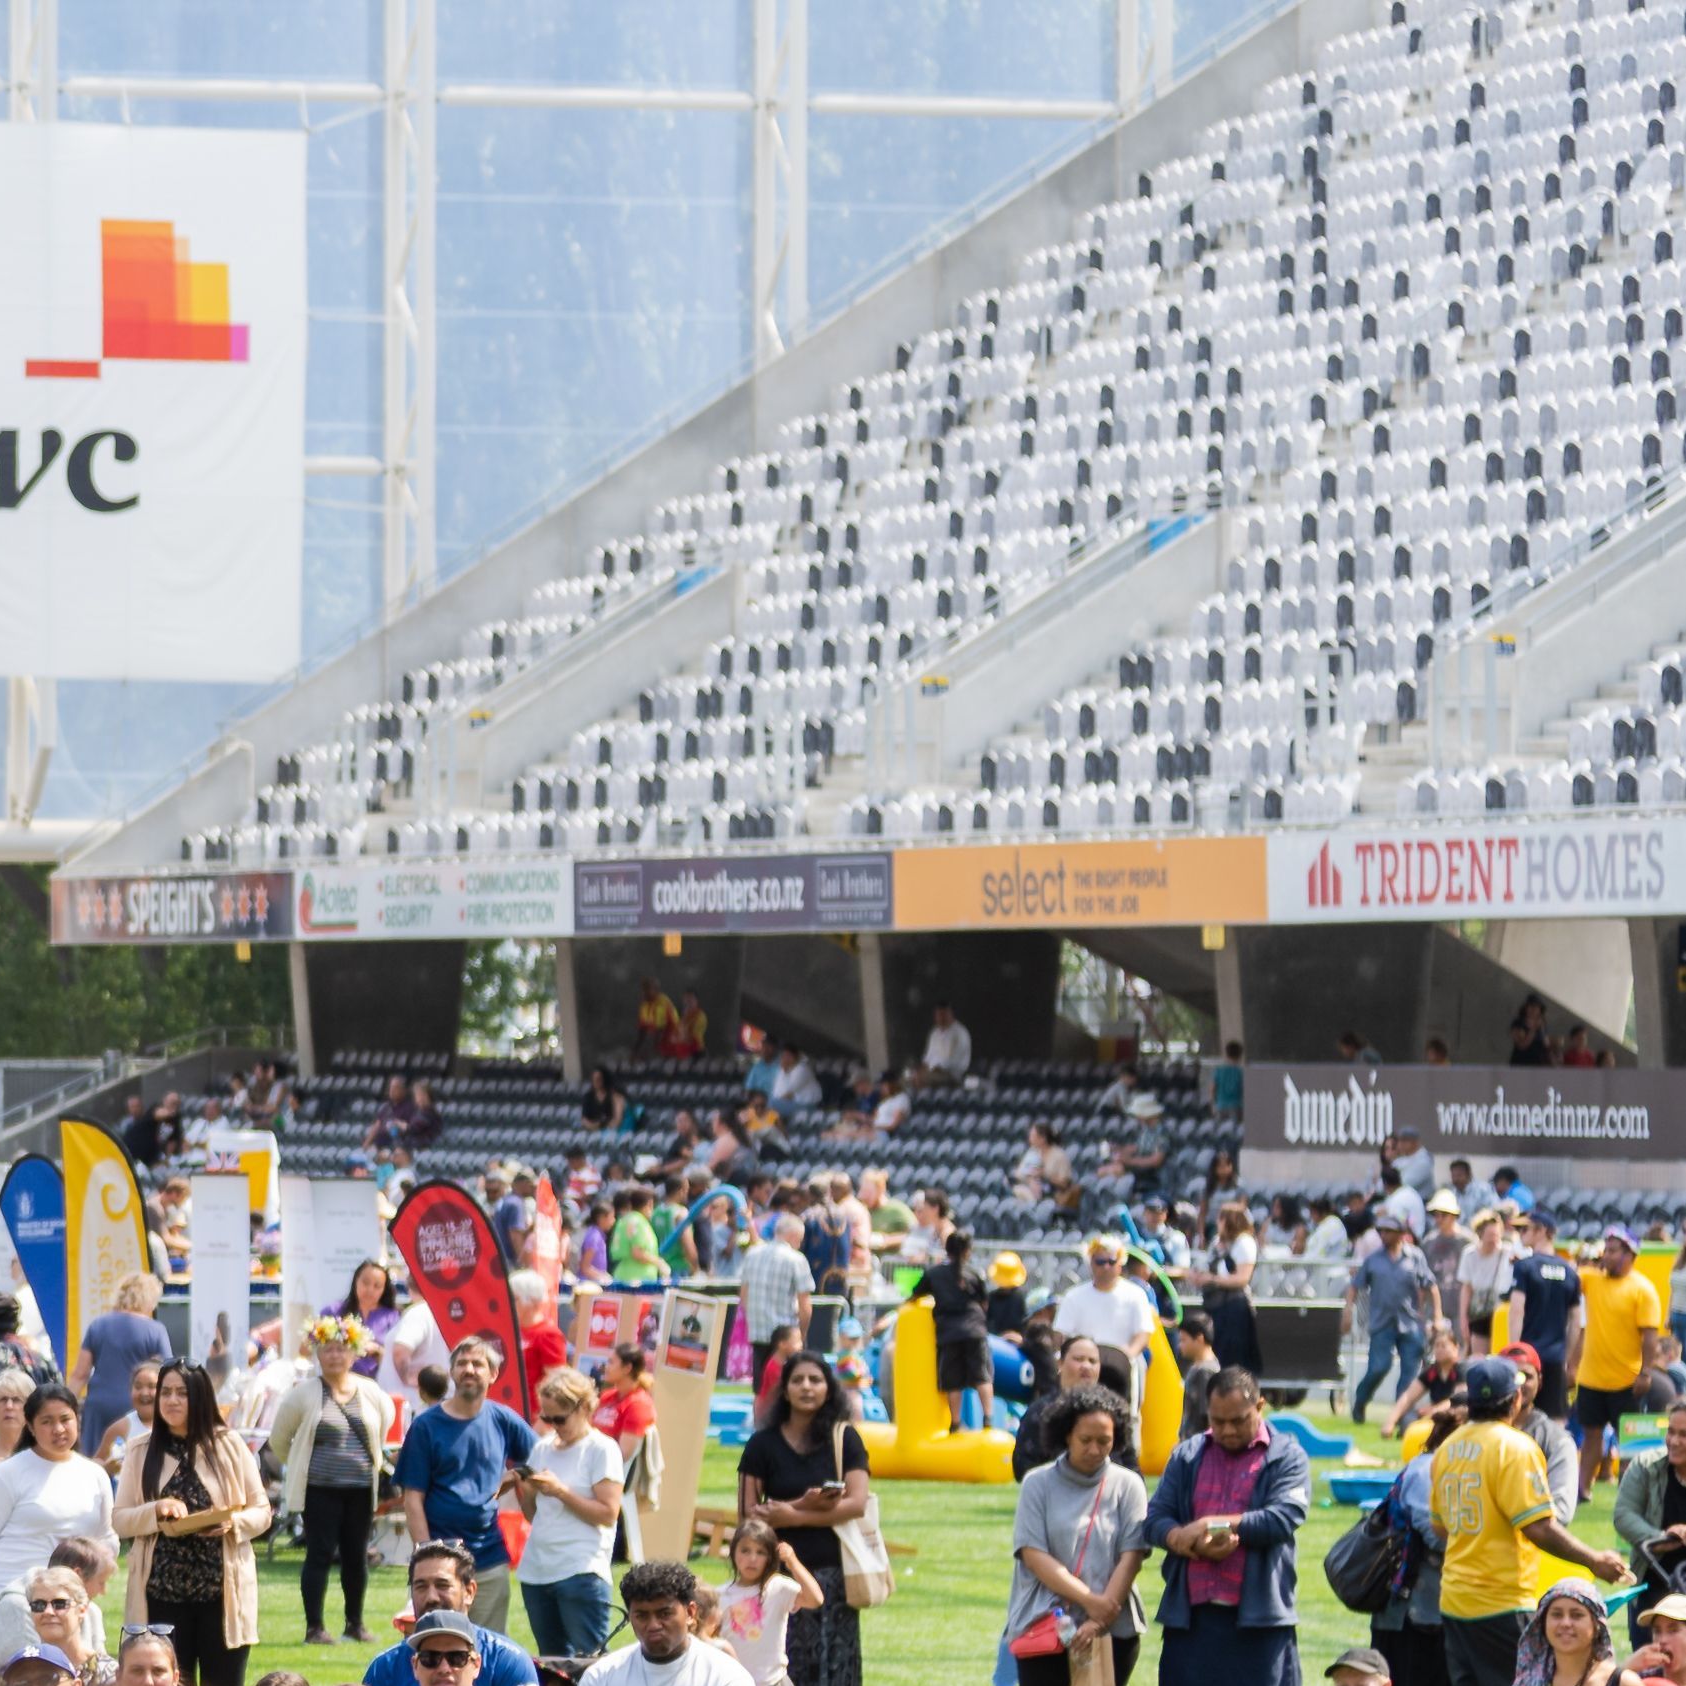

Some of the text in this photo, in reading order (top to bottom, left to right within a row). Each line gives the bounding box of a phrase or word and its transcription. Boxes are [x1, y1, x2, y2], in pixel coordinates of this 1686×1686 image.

[128, 879, 216, 935] SPEIGHT'S
[652, 868, 805, 914] cookbrothers.co.nz
[982, 848, 1066, 916] select
[1282, 1070, 1394, 1144] dunedin
[1436, 1084, 1650, 1140] www.dunedinnz.com
